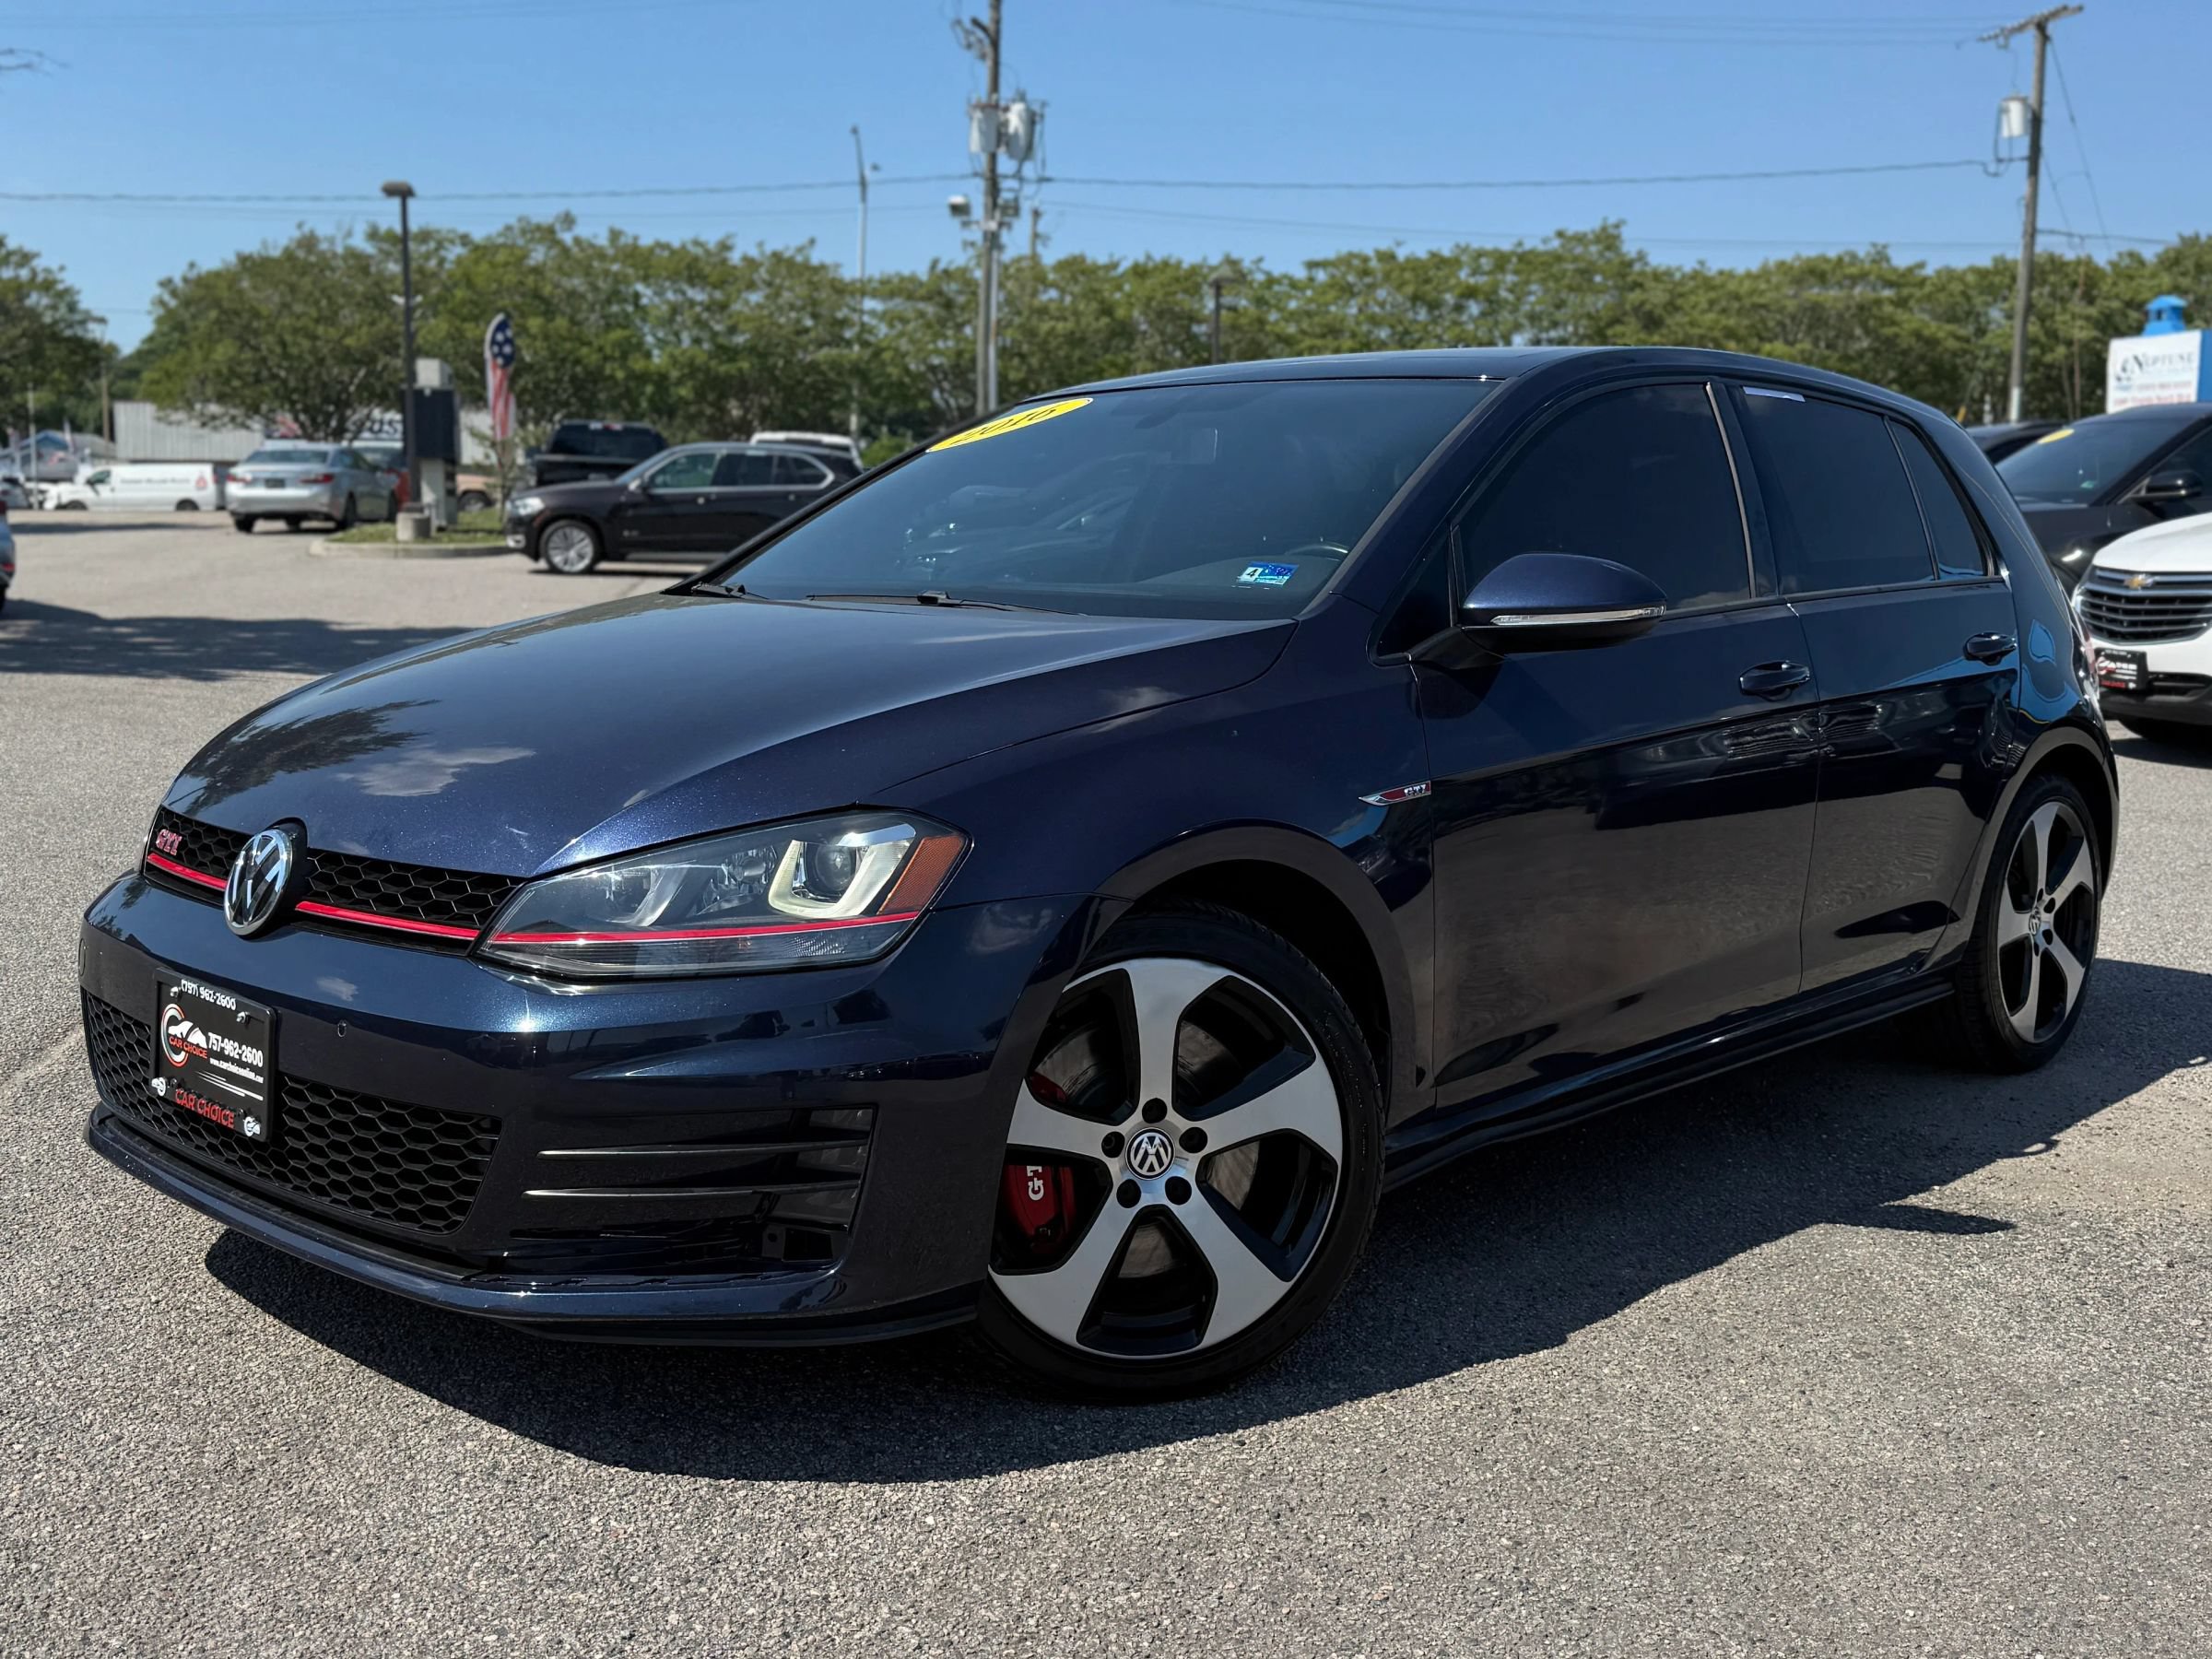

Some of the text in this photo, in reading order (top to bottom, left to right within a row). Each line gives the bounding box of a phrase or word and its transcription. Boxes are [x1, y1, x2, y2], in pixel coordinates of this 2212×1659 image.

[948, 402, 1069, 445] 2016
[1246, 568, 1259, 578] 4
[155, 829, 182, 856] GTI
[181, 979, 237, 1011] (757) 962-2600
[169, 1036, 208, 1059] CAR CHOICE
[208, 1031, 264, 1067] 757-962-2600
[175, 1089, 235, 1129] CAR CHOICE
[1026, 1165, 1044, 1201] GT
